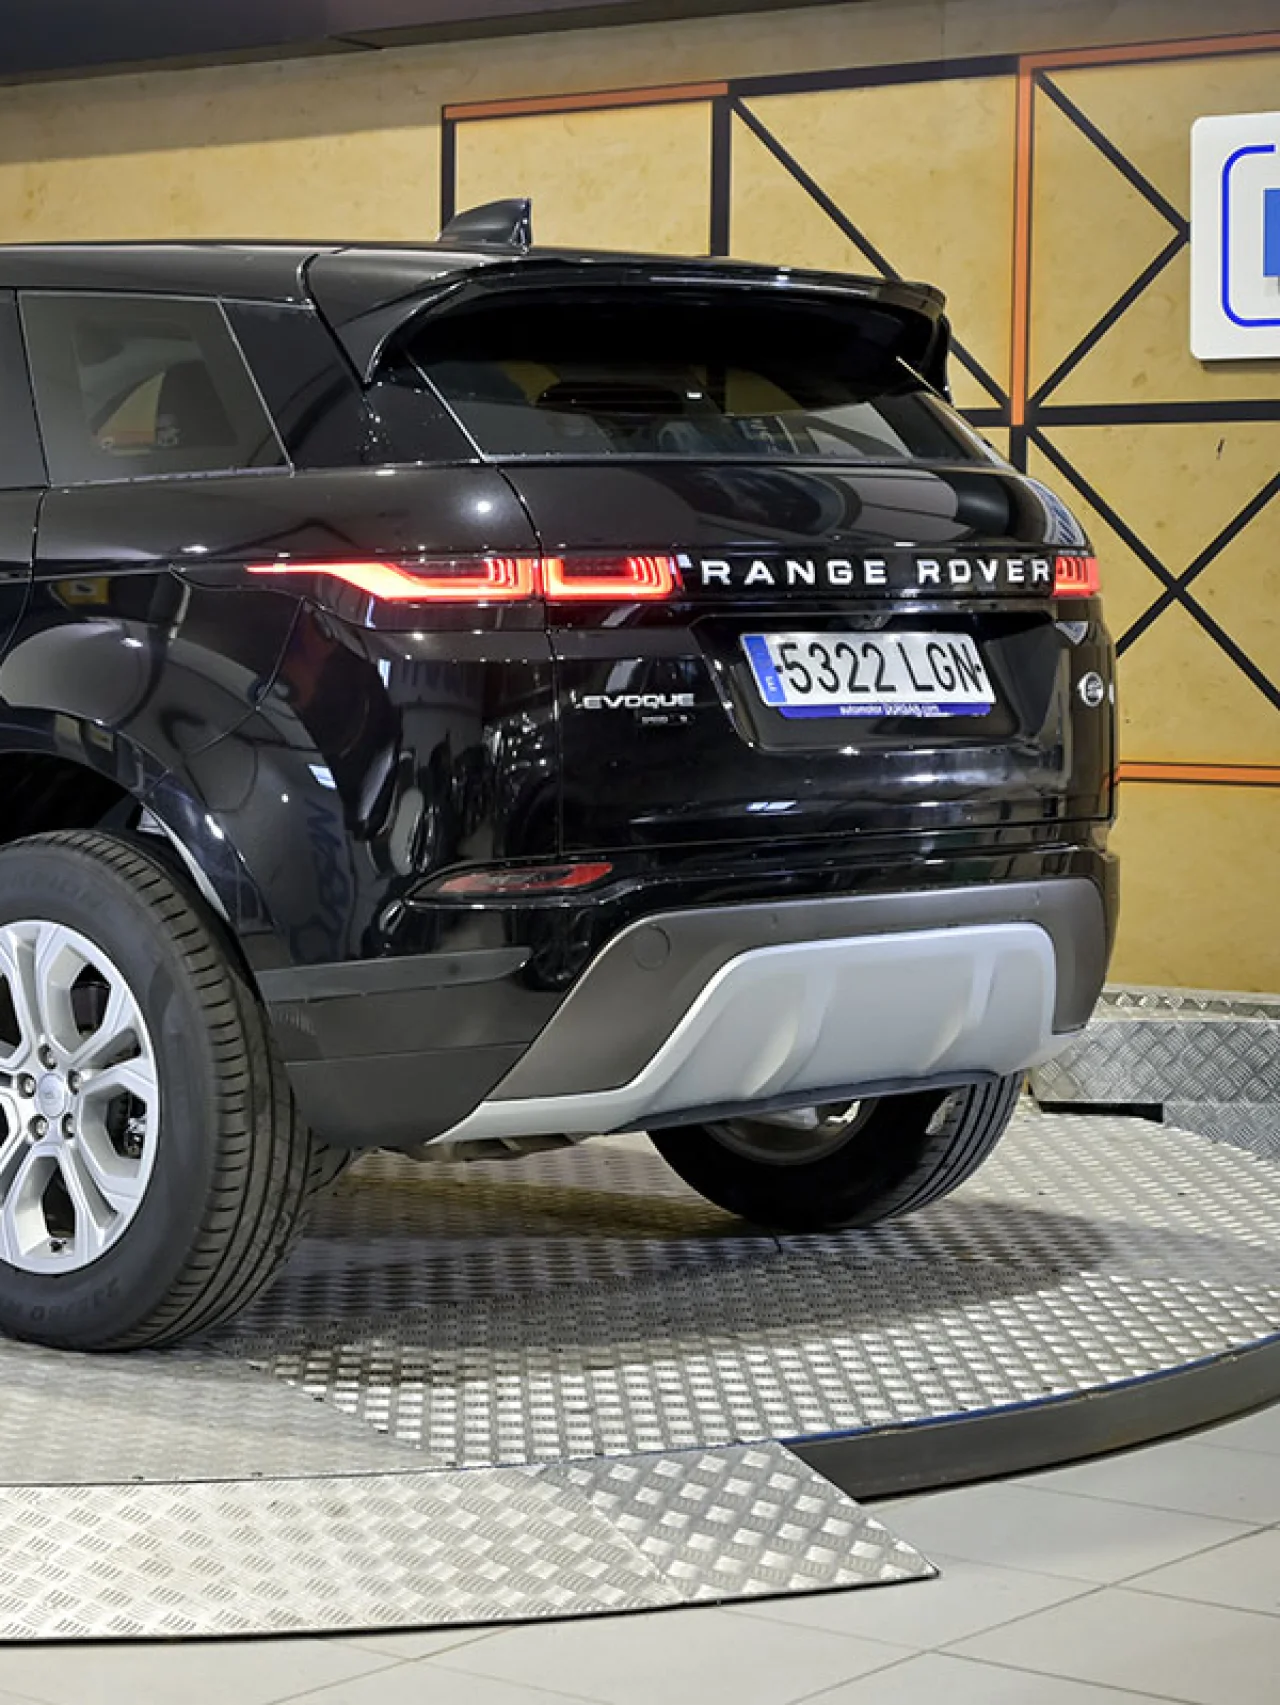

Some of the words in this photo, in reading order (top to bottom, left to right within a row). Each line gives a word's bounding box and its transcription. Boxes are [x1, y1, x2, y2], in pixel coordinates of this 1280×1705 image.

[700, 559, 888, 586] RANGE
[916, 557, 1052, 584] ROVER
[777, 641, 897, 694] 5322
[896, 641, 983, 693] LGN
[582, 693, 695, 709] EVOQUE
